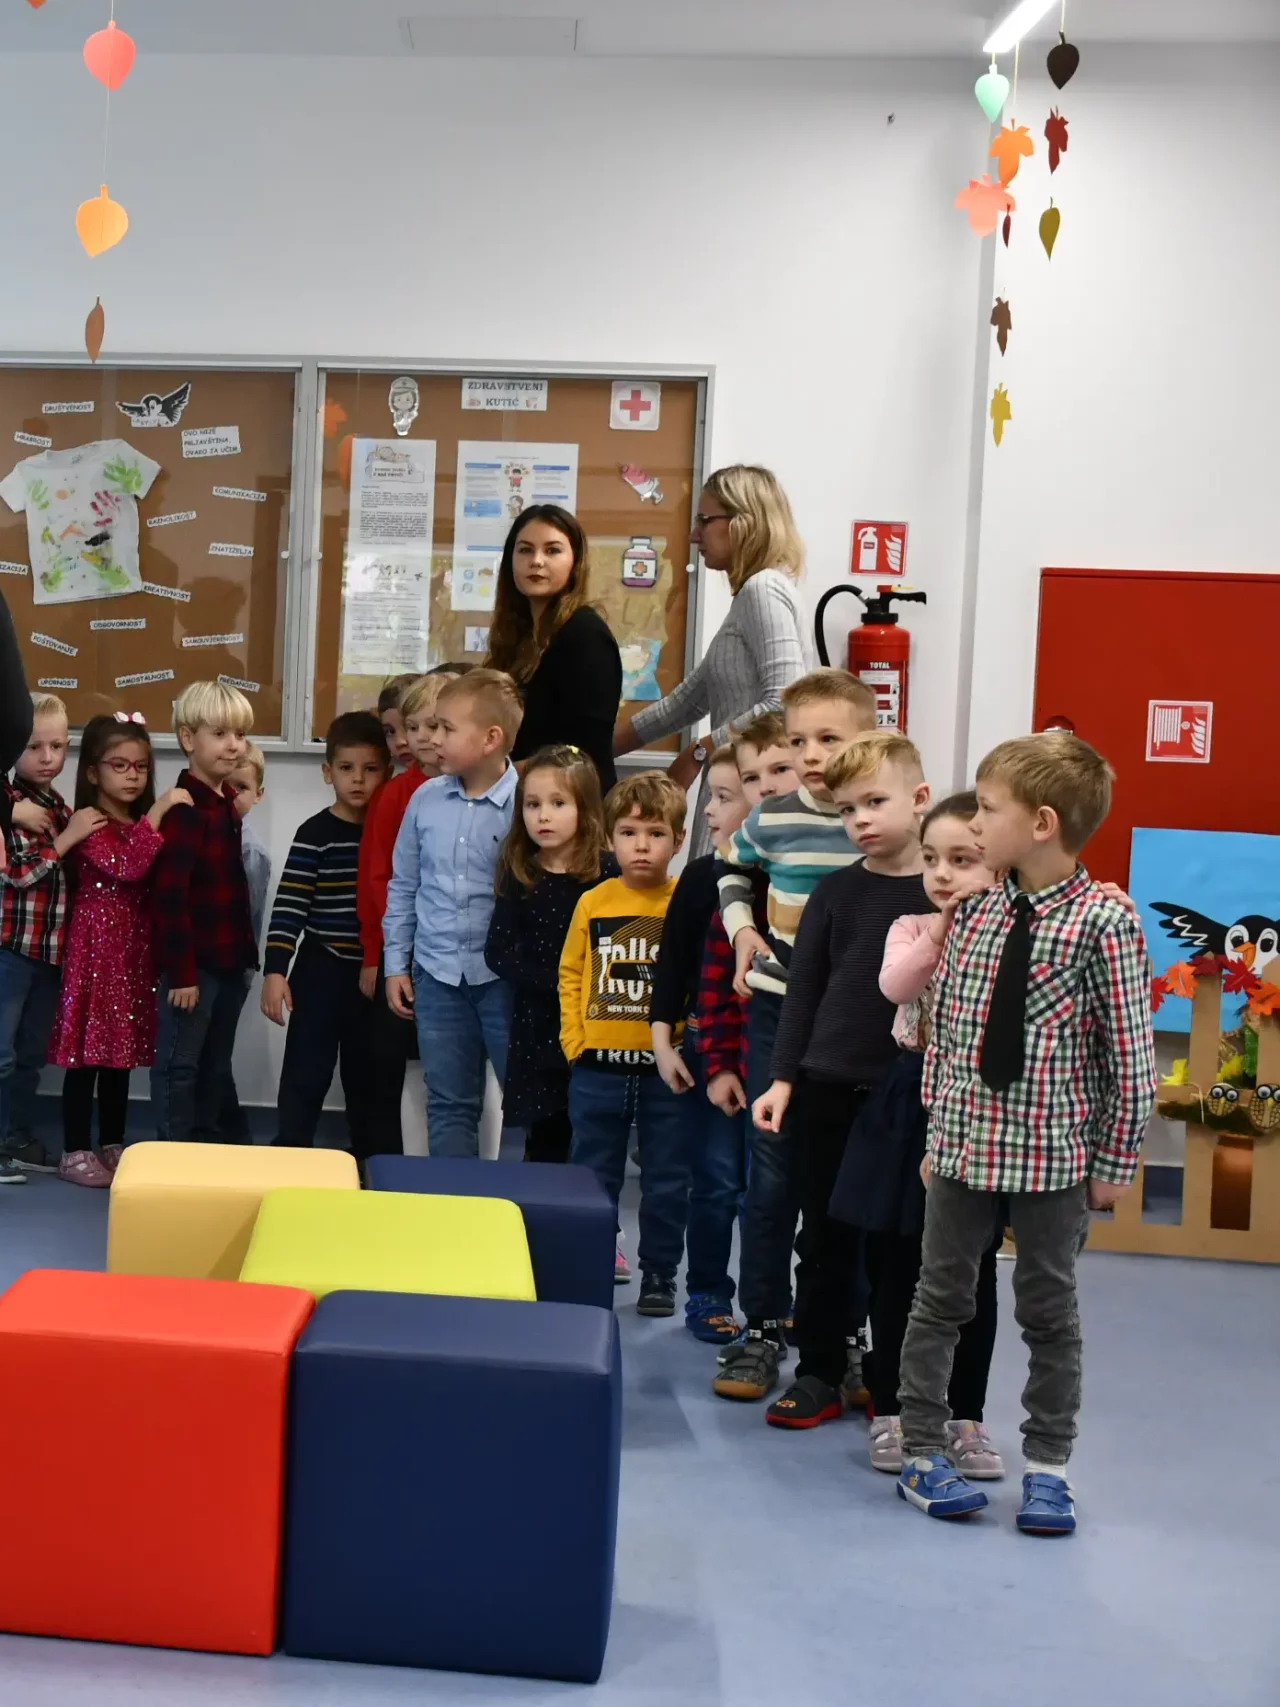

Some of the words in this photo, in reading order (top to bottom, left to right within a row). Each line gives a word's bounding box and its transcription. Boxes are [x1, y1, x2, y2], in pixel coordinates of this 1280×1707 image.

[468, 381, 544, 391] ZDRAVSTVENI
[144, 585, 189, 600] KREATIVNOST
[117, 672, 170, 685] SAMOSTALNOST
[607, 1005, 622, 1013] NEW
[624, 1005, 642, 1013] YORK
